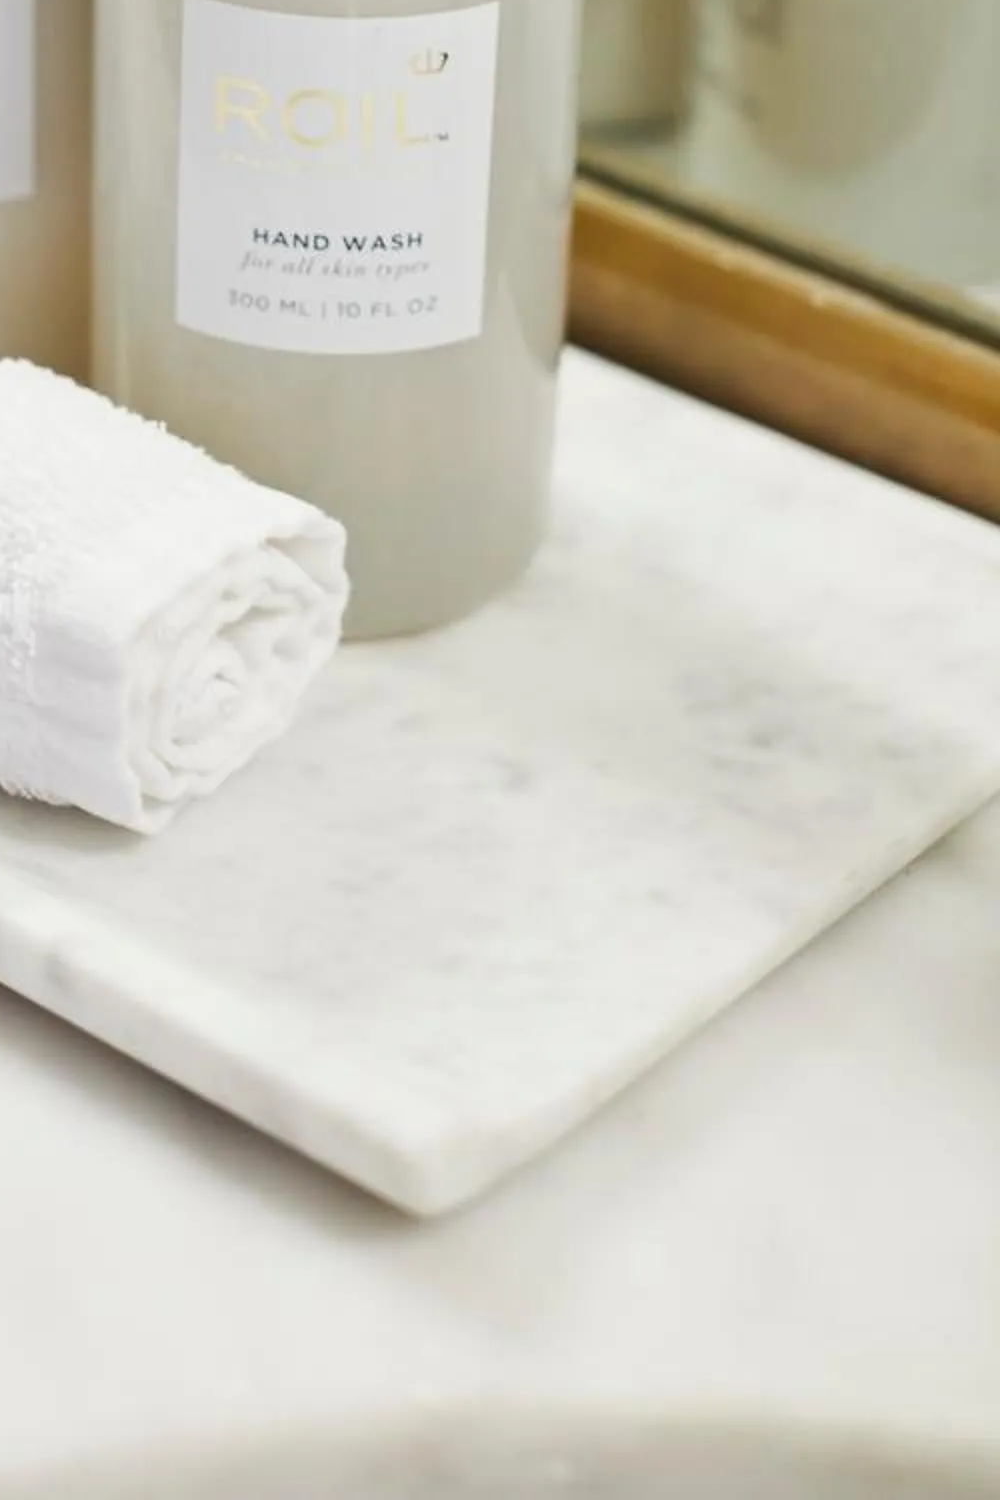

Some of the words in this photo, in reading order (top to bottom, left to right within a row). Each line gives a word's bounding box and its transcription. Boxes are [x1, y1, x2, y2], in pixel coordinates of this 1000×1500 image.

[214, 73, 434, 152] ROIL
[252, 227, 330, 251] HAND
[342, 231, 424, 252] WASH
[239, 251, 275, 272] for
[282, 257, 314, 277] all
[321, 260, 367, 279] skin
[375, 260, 432, 283] types
[228, 288, 271, 313] 300
[278, 299, 313, 318] ML
[336, 300, 362, 319] 10
[370, 301, 399, 318] FL
[406, 295, 439, 316] OZ
